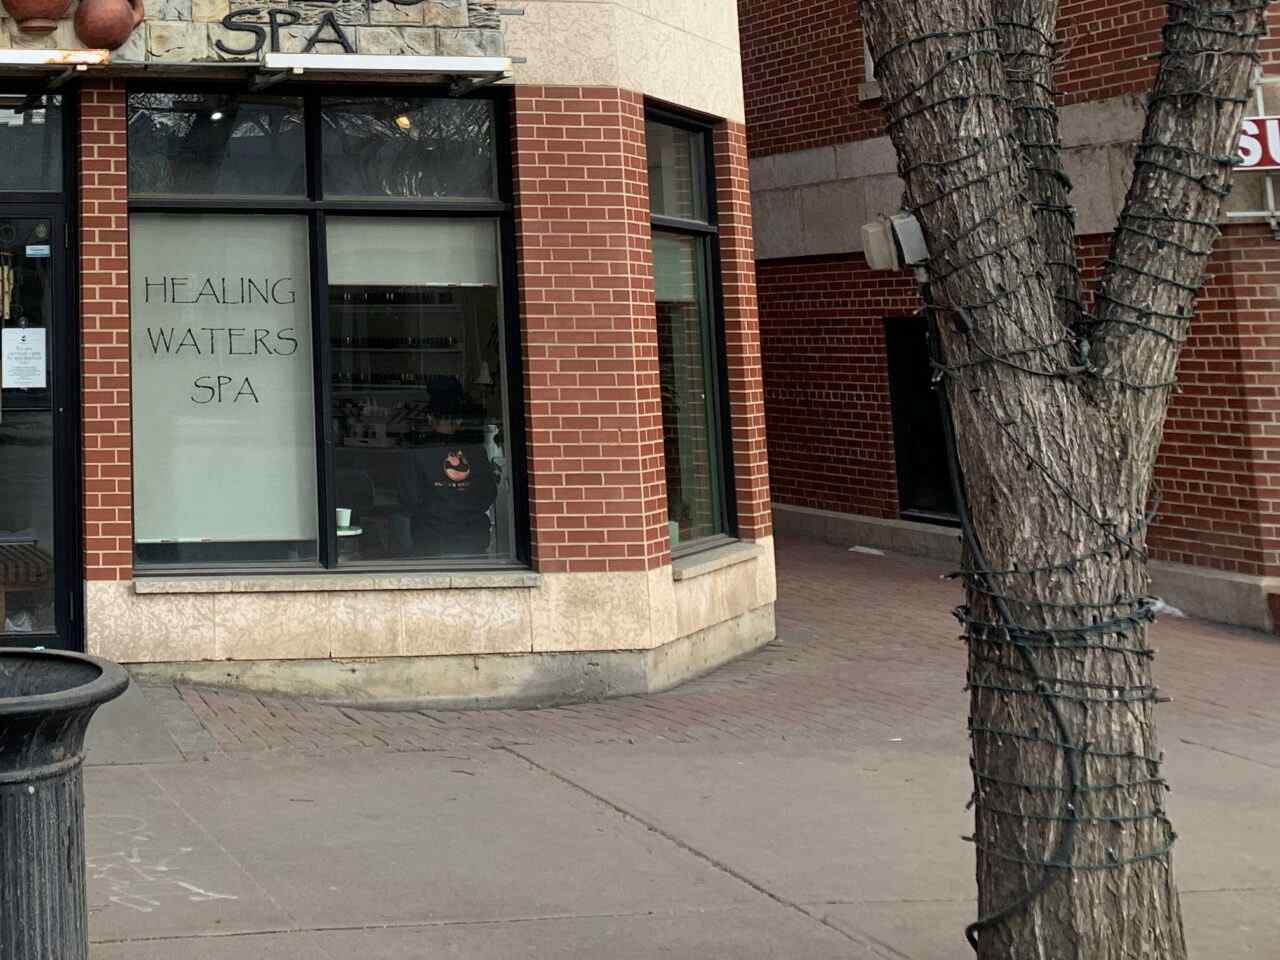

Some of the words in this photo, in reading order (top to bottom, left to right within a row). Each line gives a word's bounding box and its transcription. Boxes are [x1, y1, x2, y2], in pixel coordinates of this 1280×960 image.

[216, 8, 356, 55] SPA
[143, 276, 297, 305] HEALING
[146, 327, 299, 356] WATERS
[190, 375, 260, 405] SPA
